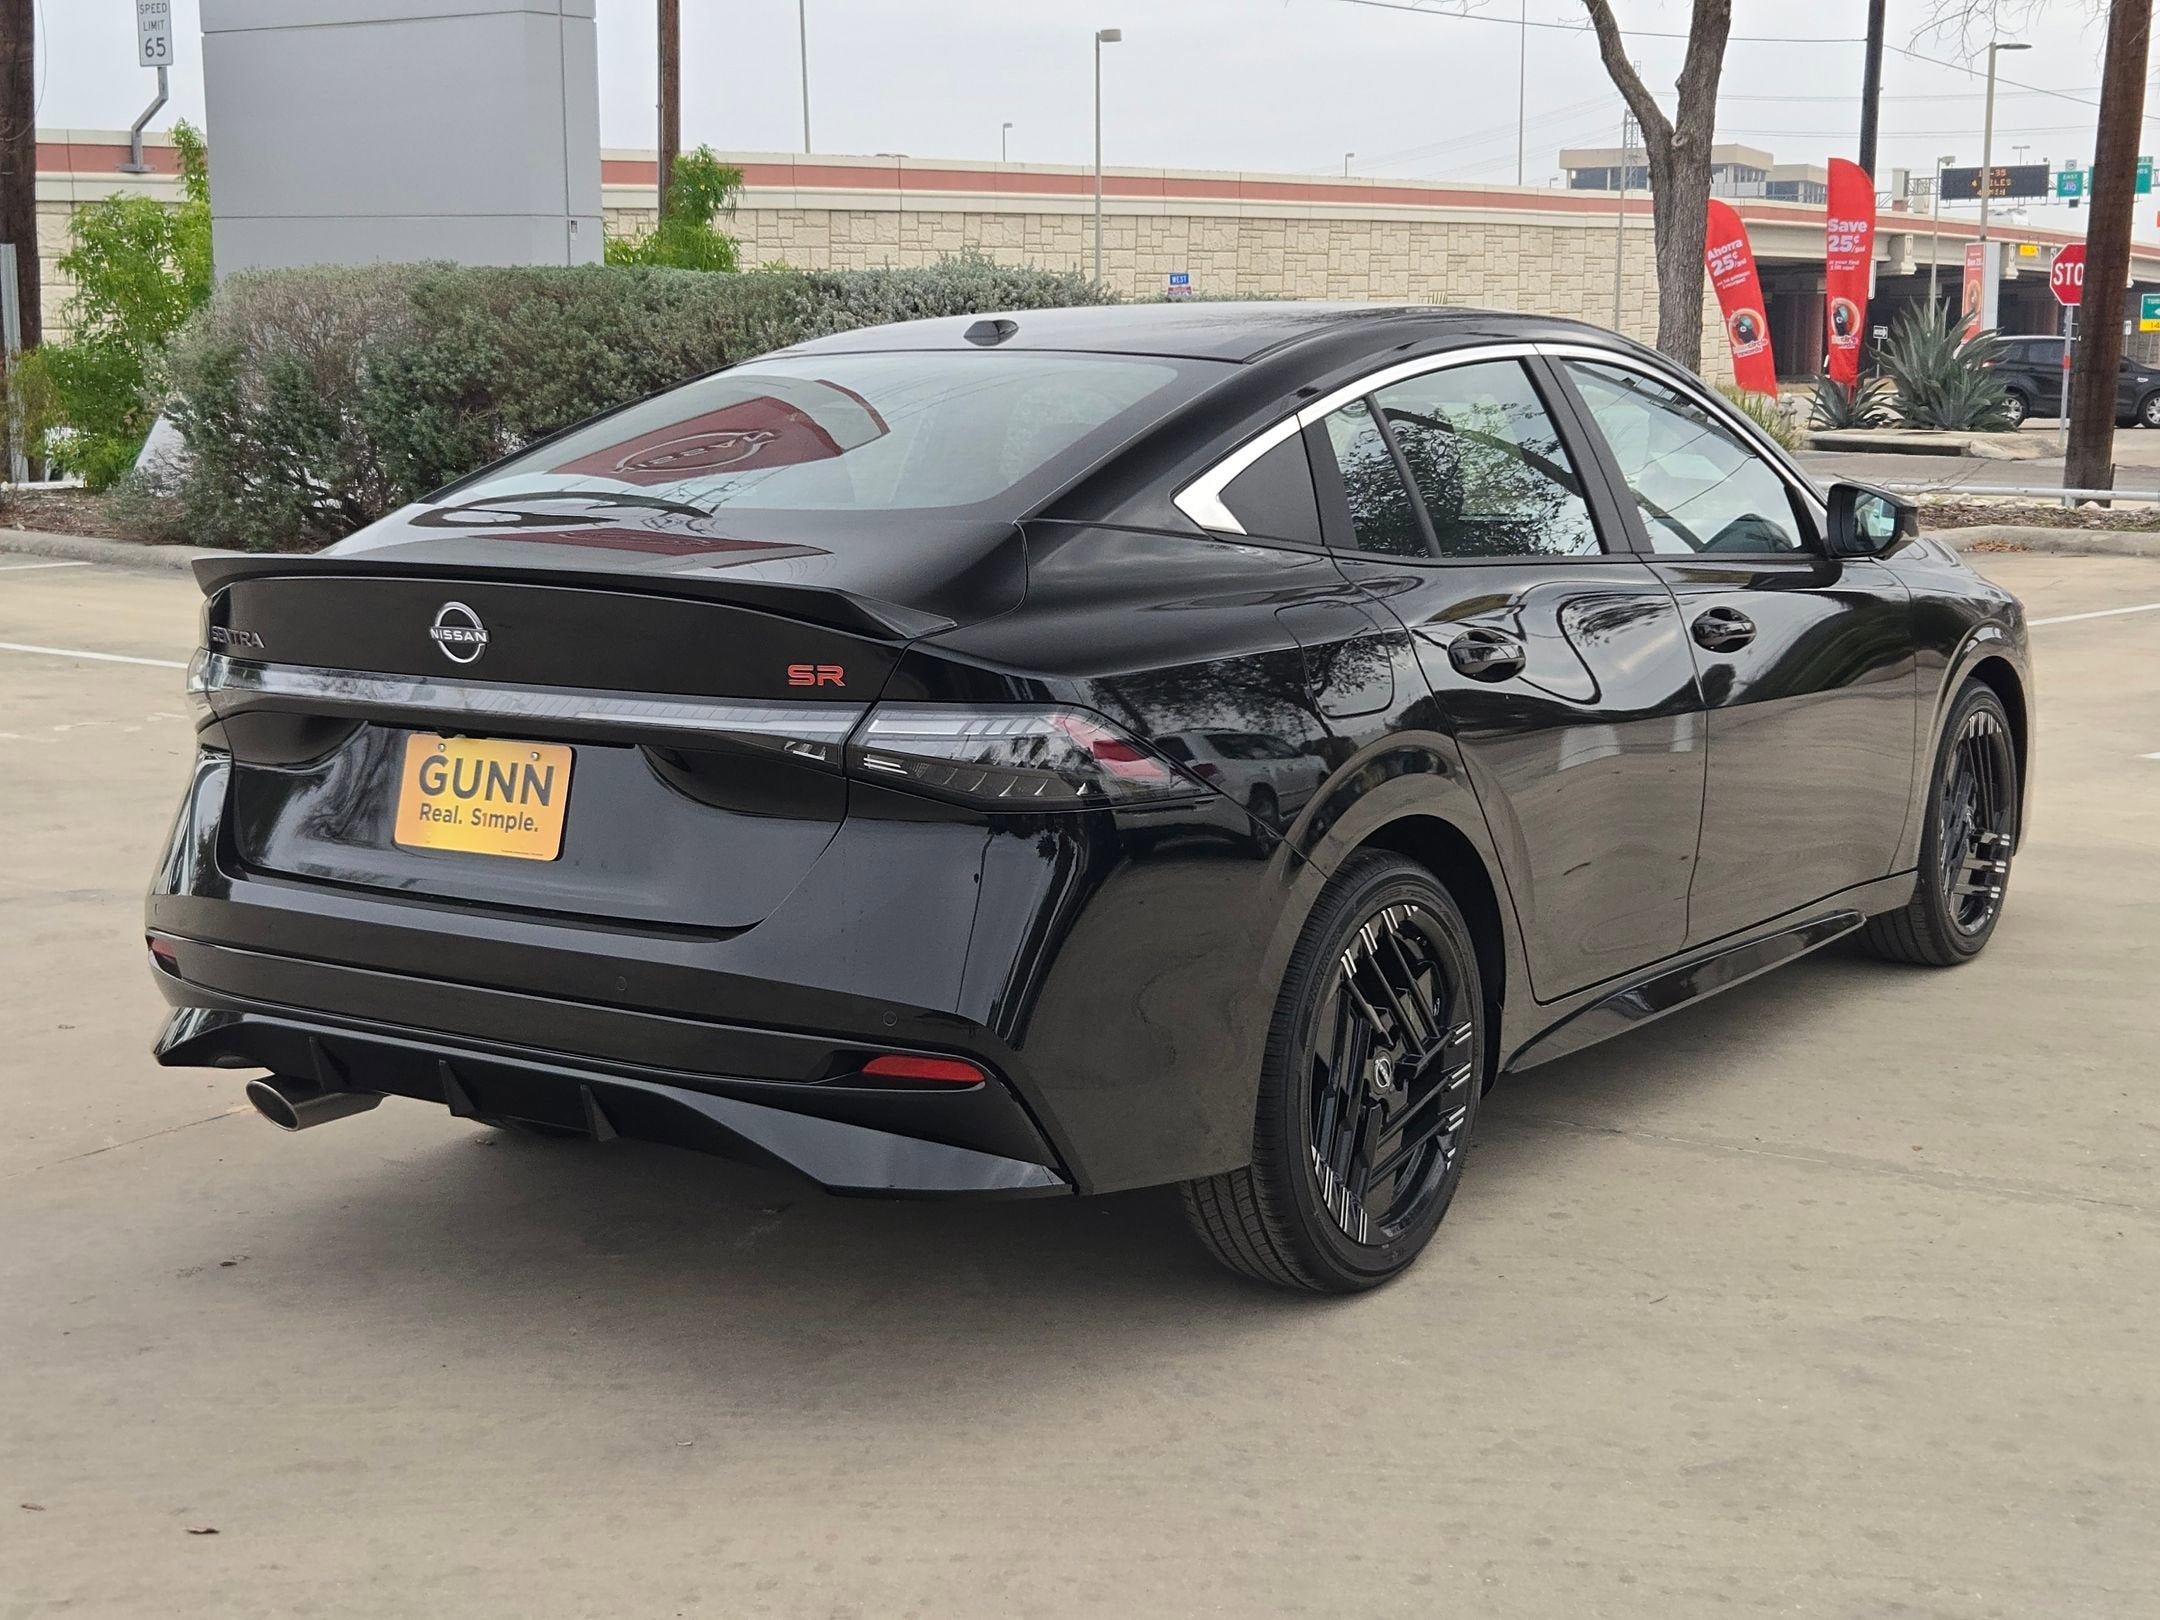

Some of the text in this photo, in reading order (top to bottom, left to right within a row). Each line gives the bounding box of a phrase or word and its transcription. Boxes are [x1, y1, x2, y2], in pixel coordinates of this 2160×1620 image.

[139, 3, 168, 15] SPEED
[143, 20, 165, 32] LIMIT
[145, 36, 166, 58] 65
[1988, 178, 2012, 187] ILES
[1828, 218, 1868, 233] Save
[1707, 239, 1744, 261] Ahorra
[1171, 275, 1187, 283] WEST
[2053, 262, 2084, 286] STO
[430, 627, 487, 643] NISSAN
[787, 664, 846, 687] SR
[419, 754, 555, 807] GUNN
[419, 802, 463, 825] Real.
